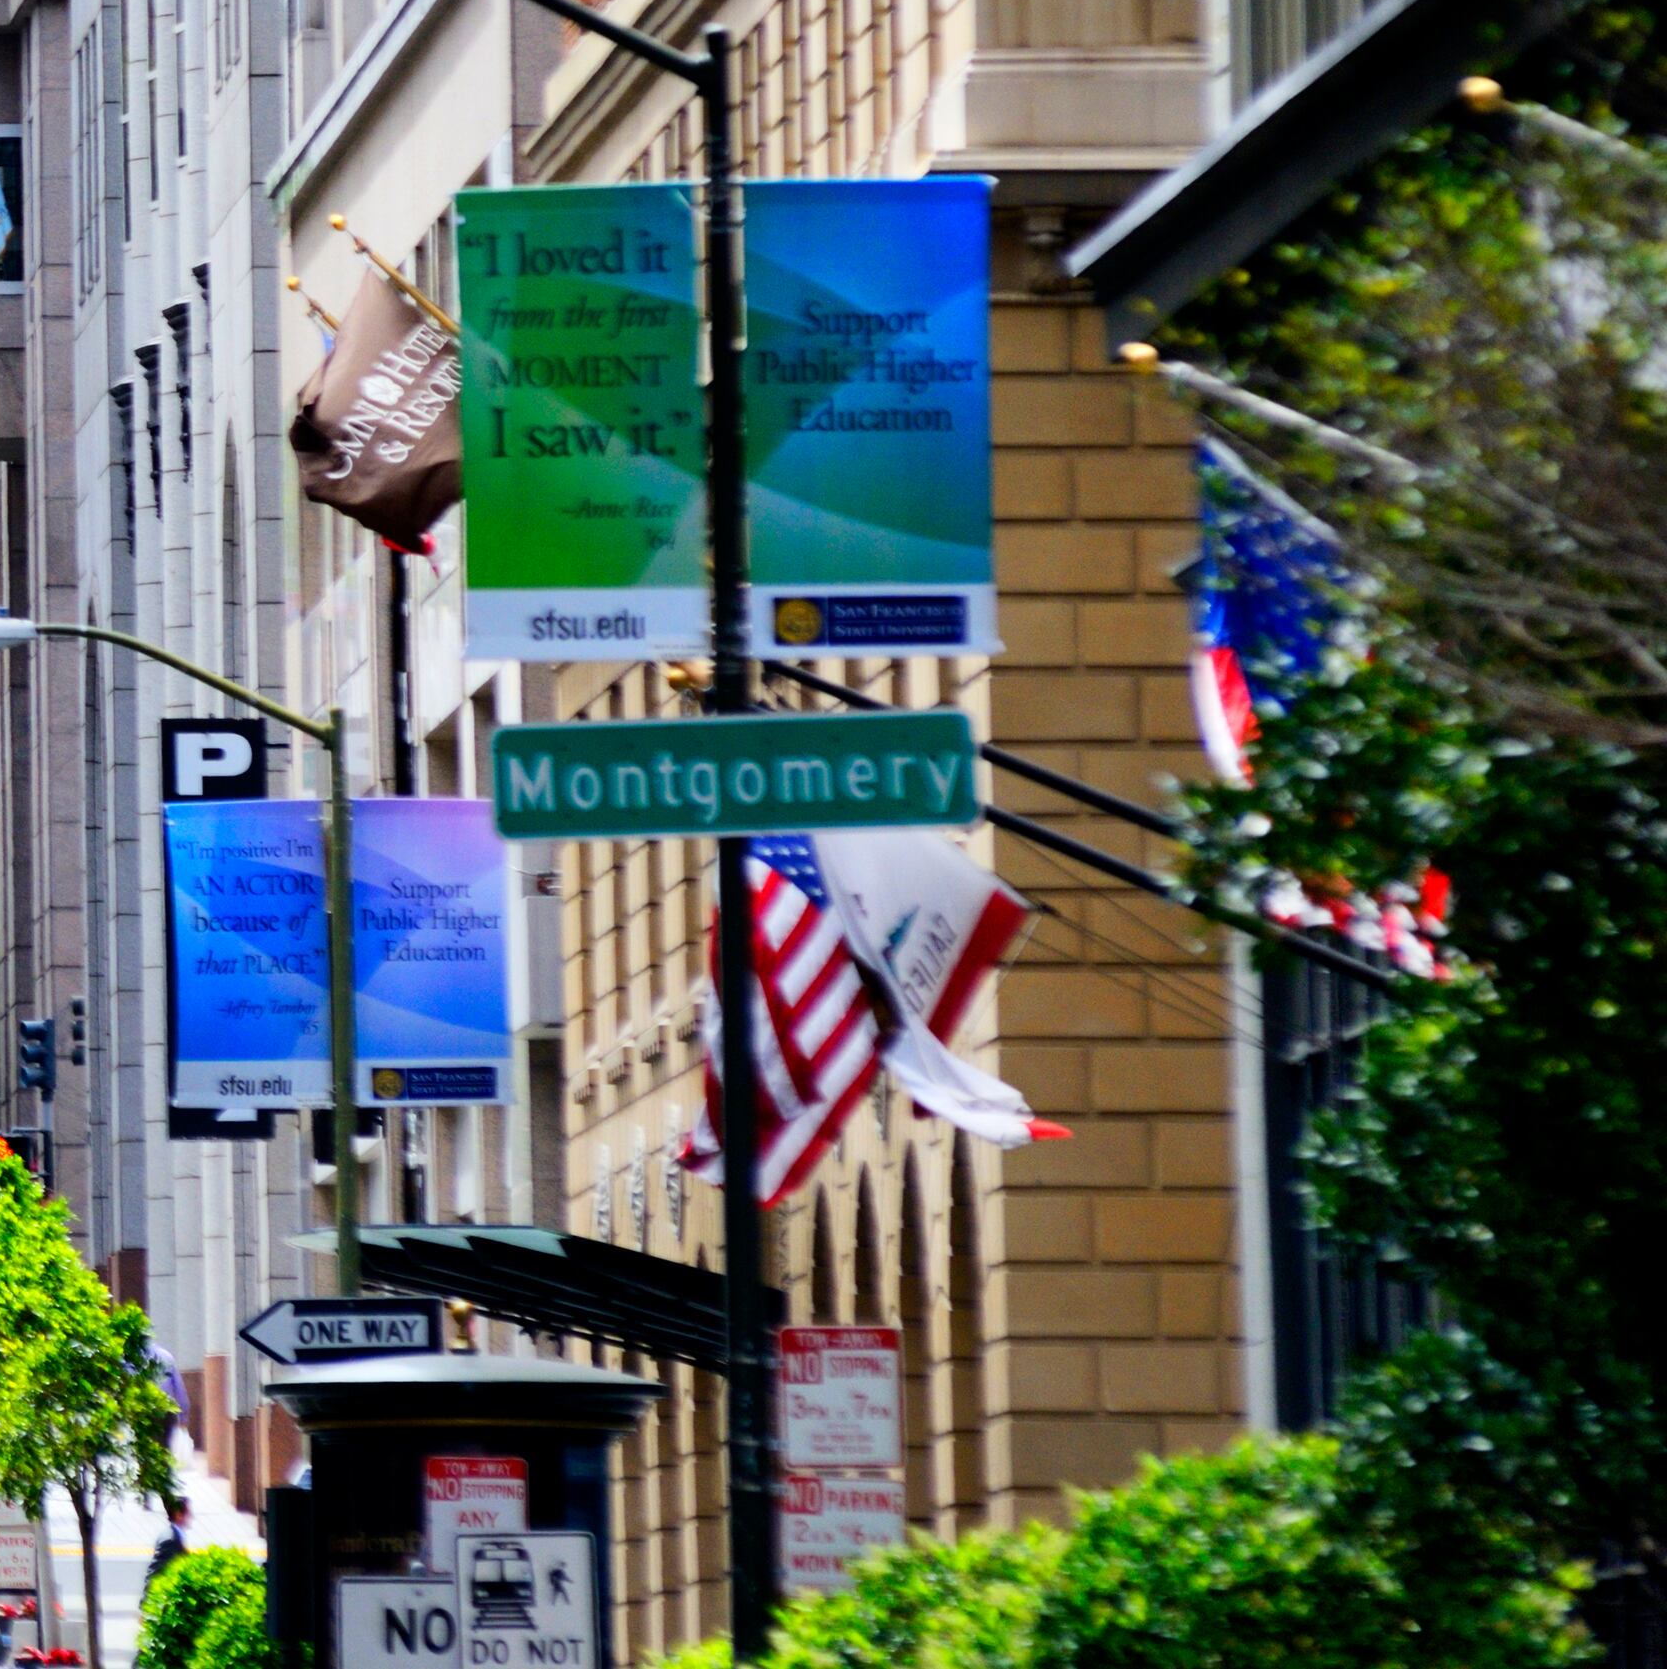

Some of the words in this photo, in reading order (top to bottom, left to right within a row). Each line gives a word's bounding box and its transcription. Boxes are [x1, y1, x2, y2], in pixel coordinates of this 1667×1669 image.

[519, 231, 626, 274] loved
[641, 232, 670, 274] it
[490, 298, 558, 345] from
[569, 295, 606, 330] the
[614, 294, 670, 345] first
[801, 302, 927, 346] Support
[378, 323, 450, 384] HOTEL
[490, 354, 670, 389] MOMENT
[758, 349, 854, 385] Public
[868, 351, 977, 396] Higher
[383, 356, 463, 440] RESORT
[792, 396, 953, 432] Education
[489, 406, 508, 460] I
[527, 422, 616, 458] saw
[531, 609, 646, 641] sfsu.edu
[834, 605, 867, 617] SAN
[872, 604, 964, 617] FRANCISCO
[175, 732, 253, 796] P
[507, 751, 962, 823] Montgomery
[221, 840, 282, 869] positive
[194, 876, 225, 896] AN
[234, 874, 316, 896] ACTOR
[390, 879, 471, 902] Support
[195, 909, 279, 933] because
[289, 906, 312, 941] of
[360, 910, 423, 931] Public
[432, 908, 501, 937] Higher
[196, 952, 237, 975] that
[385, 941, 485, 963] Education
[219, 1075, 292, 1096] sfsu.edu
[298, 1319, 353, 1346] ONE
[364, 1317, 419, 1345] WAY
[788, 1352, 820, 1383] NO
[829, 1357, 893, 1379] STOPPING
[443, 1462, 512, 1475] TOW-AWAY
[431, 1480, 459, 1500] NO
[463, 1484, 525, 1501] STOPPING
[786, 1479, 820, 1513] NO
[826, 1490, 904, 1514] PARKING
[458, 1511, 500, 1528] ANY
[0, 1537, 34, 1548] PARKING
[383, 1607, 456, 1655] NO
[472, 1639, 509, 1664] DO
[528, 1638, 584, 1665] NOT
